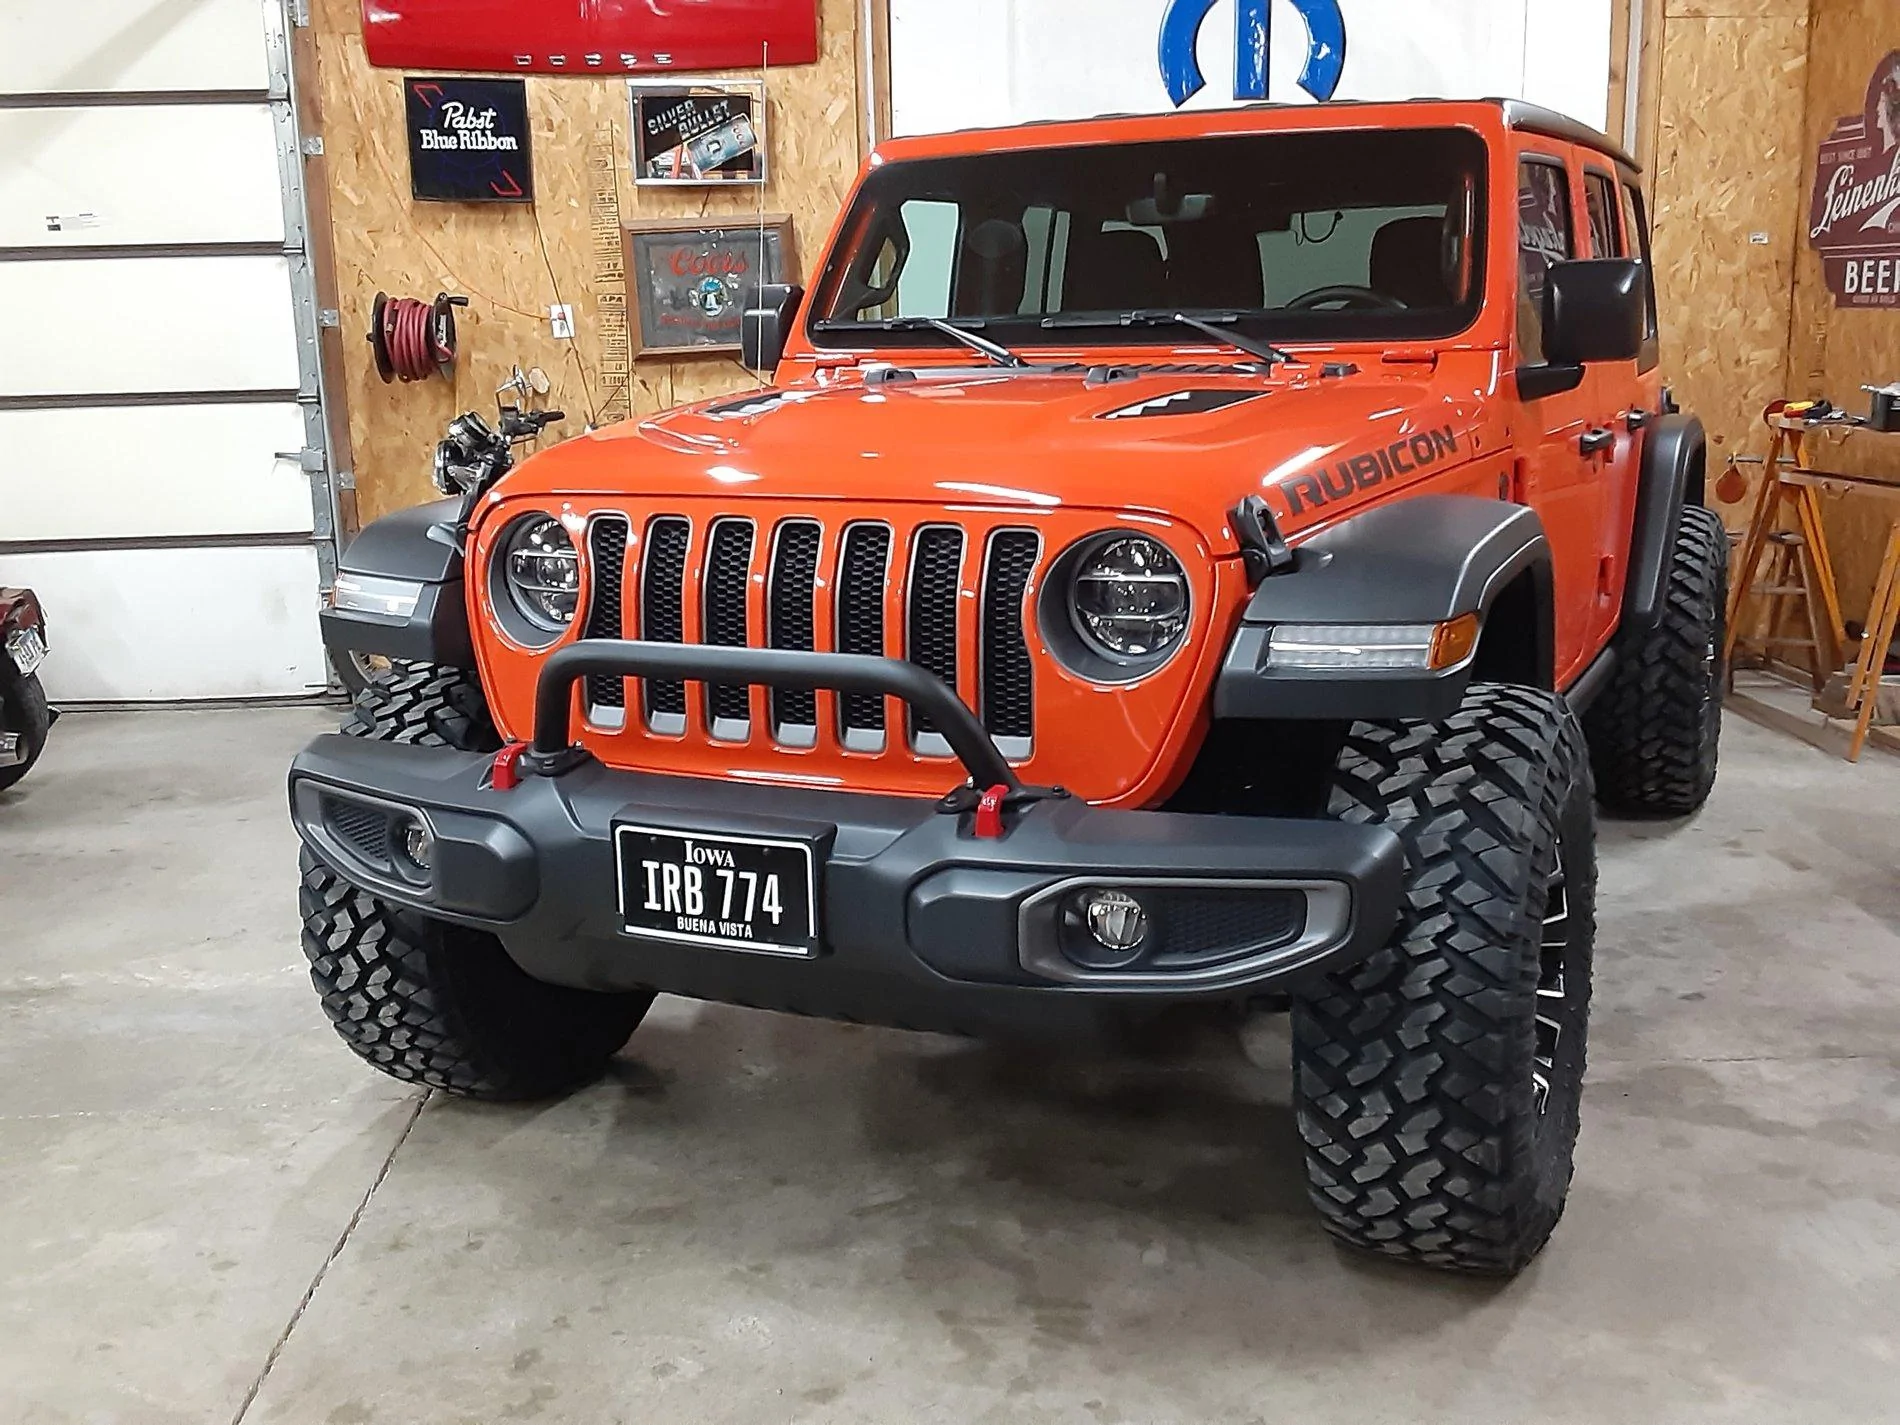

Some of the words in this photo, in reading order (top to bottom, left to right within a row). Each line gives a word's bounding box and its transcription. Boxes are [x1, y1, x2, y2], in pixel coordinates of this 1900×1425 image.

[441, 101, 497, 129] Pabst
[647, 99, 696, 136] SILVER
[679, 99, 731, 140] BULLET
[420, 129, 458, 149] Blue
[457, 129, 518, 150] Ribbon
[670, 247, 749, 276] Coors
[1280, 425, 1458, 516] RUBICON
[642, 860, 704, 916] IRB
[715, 869, 783, 925] 774
[677, 916, 716, 935] BUENA
[719, 921, 753, 939] VISTA
